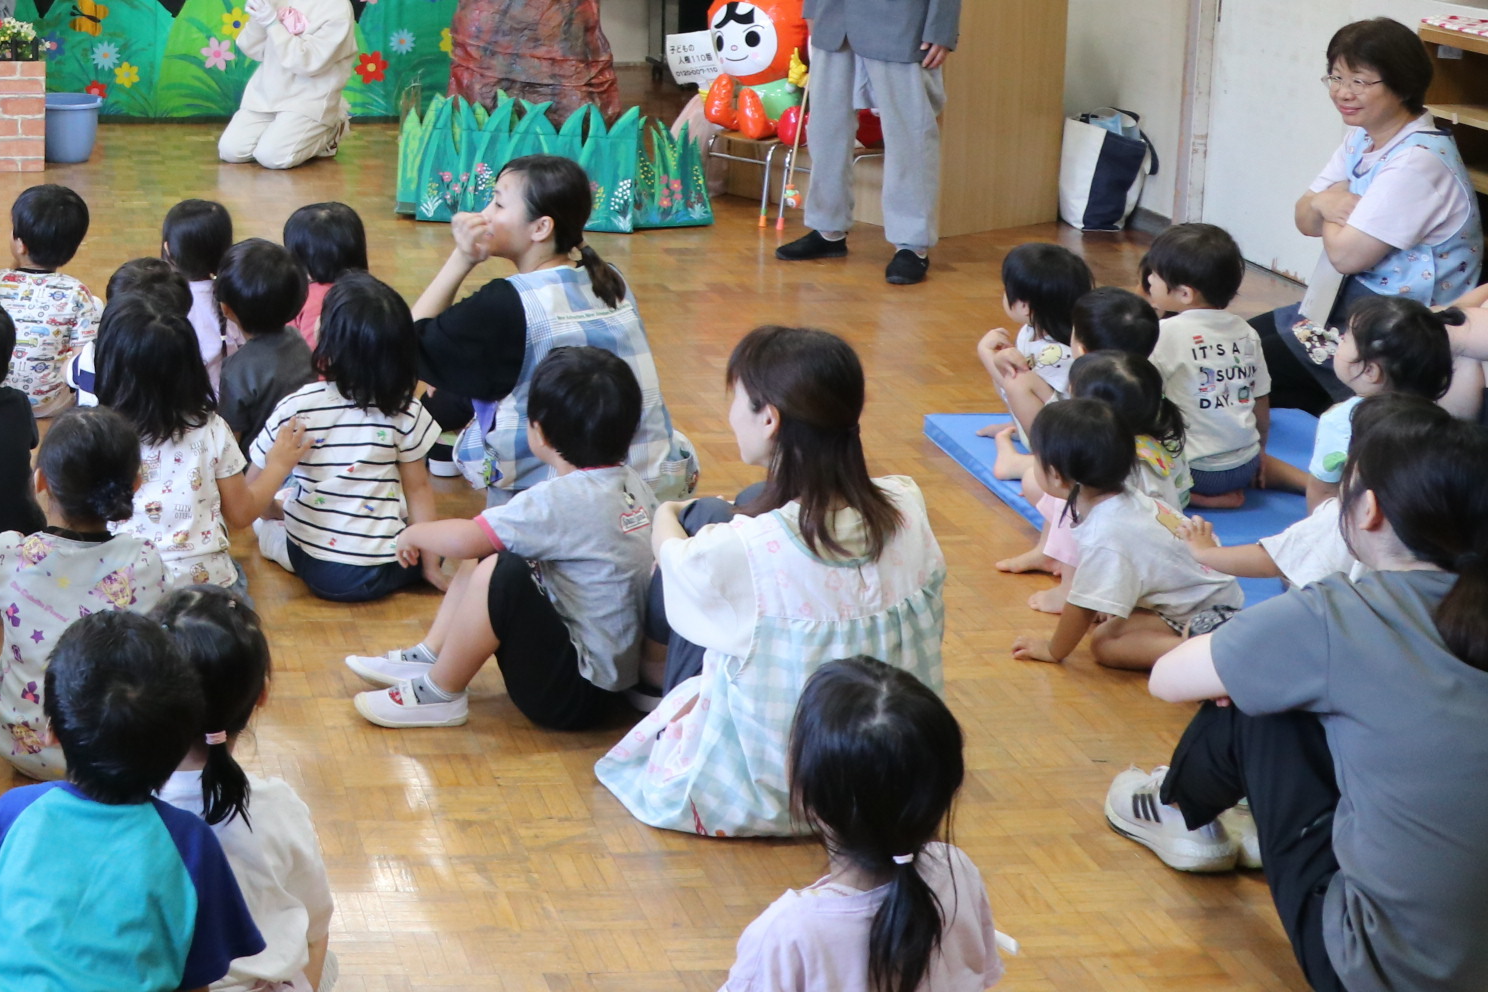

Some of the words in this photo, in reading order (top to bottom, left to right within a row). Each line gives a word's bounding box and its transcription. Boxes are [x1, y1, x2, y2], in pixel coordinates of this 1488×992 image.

[1192, 344, 1225, 360] IT'S
[1232, 342, 1240, 354] A
[1200, 394, 1233, 409] DAY.
